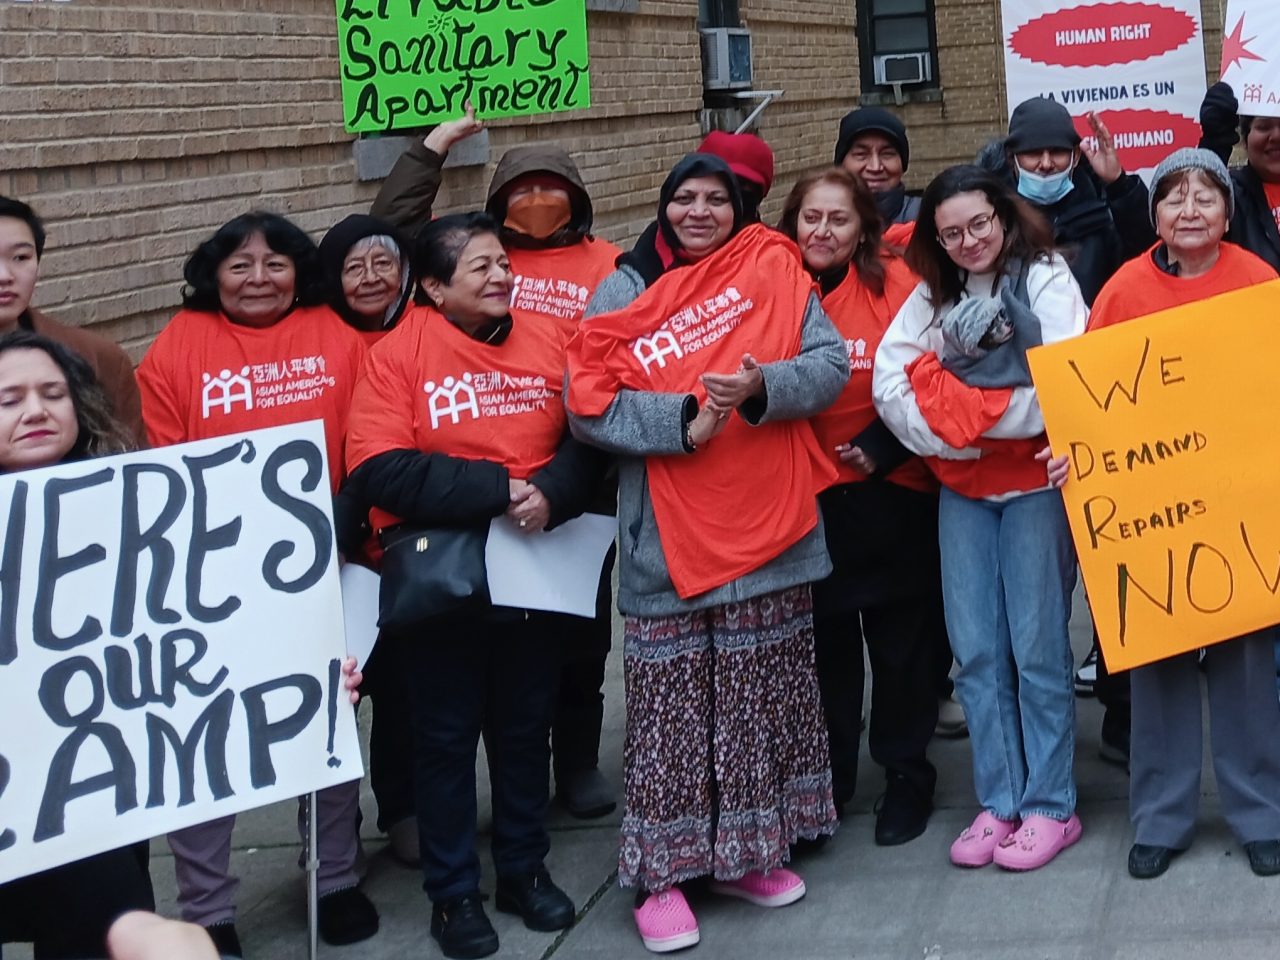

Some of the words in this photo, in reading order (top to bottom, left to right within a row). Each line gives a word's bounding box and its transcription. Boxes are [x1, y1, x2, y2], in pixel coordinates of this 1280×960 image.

[1055, 27, 1106, 47] HUMAN
[1110, 23, 1152, 42] RIGHT
[344, 14, 568, 81] Sanitary
[348, 60, 589, 131] Apartment
[1062, 87, 1129, 104] VIVIENDA
[1133, 84, 1150, 98] ES
[1155, 81, 1175, 95] UN
[1113, 129, 1174, 150] HUMANO
[516, 300, 535, 311] FOR
[535, 302, 577, 320] EQUALITY
[518, 290, 545, 302] ASIAN
[546, 294, 588, 311] AMERICAN
[679, 326, 706, 345] ASIAN
[706, 298, 754, 333] AMERICANS
[683, 340, 704, 355] FOR
[703, 315, 743, 347] EQUALITY
[1068, 337, 1187, 412] WE
[255, 383, 284, 397] ASIAN
[255, 397, 276, 409] FOR
[277, 387, 324, 407] EQUALITY
[479, 392, 505, 406] ASIAN
[481, 405, 498, 417] FOR
[499, 399, 546, 417] EQUALITY
[1070, 431, 1208, 482] DEMAND
[1083, 498, 1208, 550] REPAIRS
[38, 628, 230, 728] OUR
